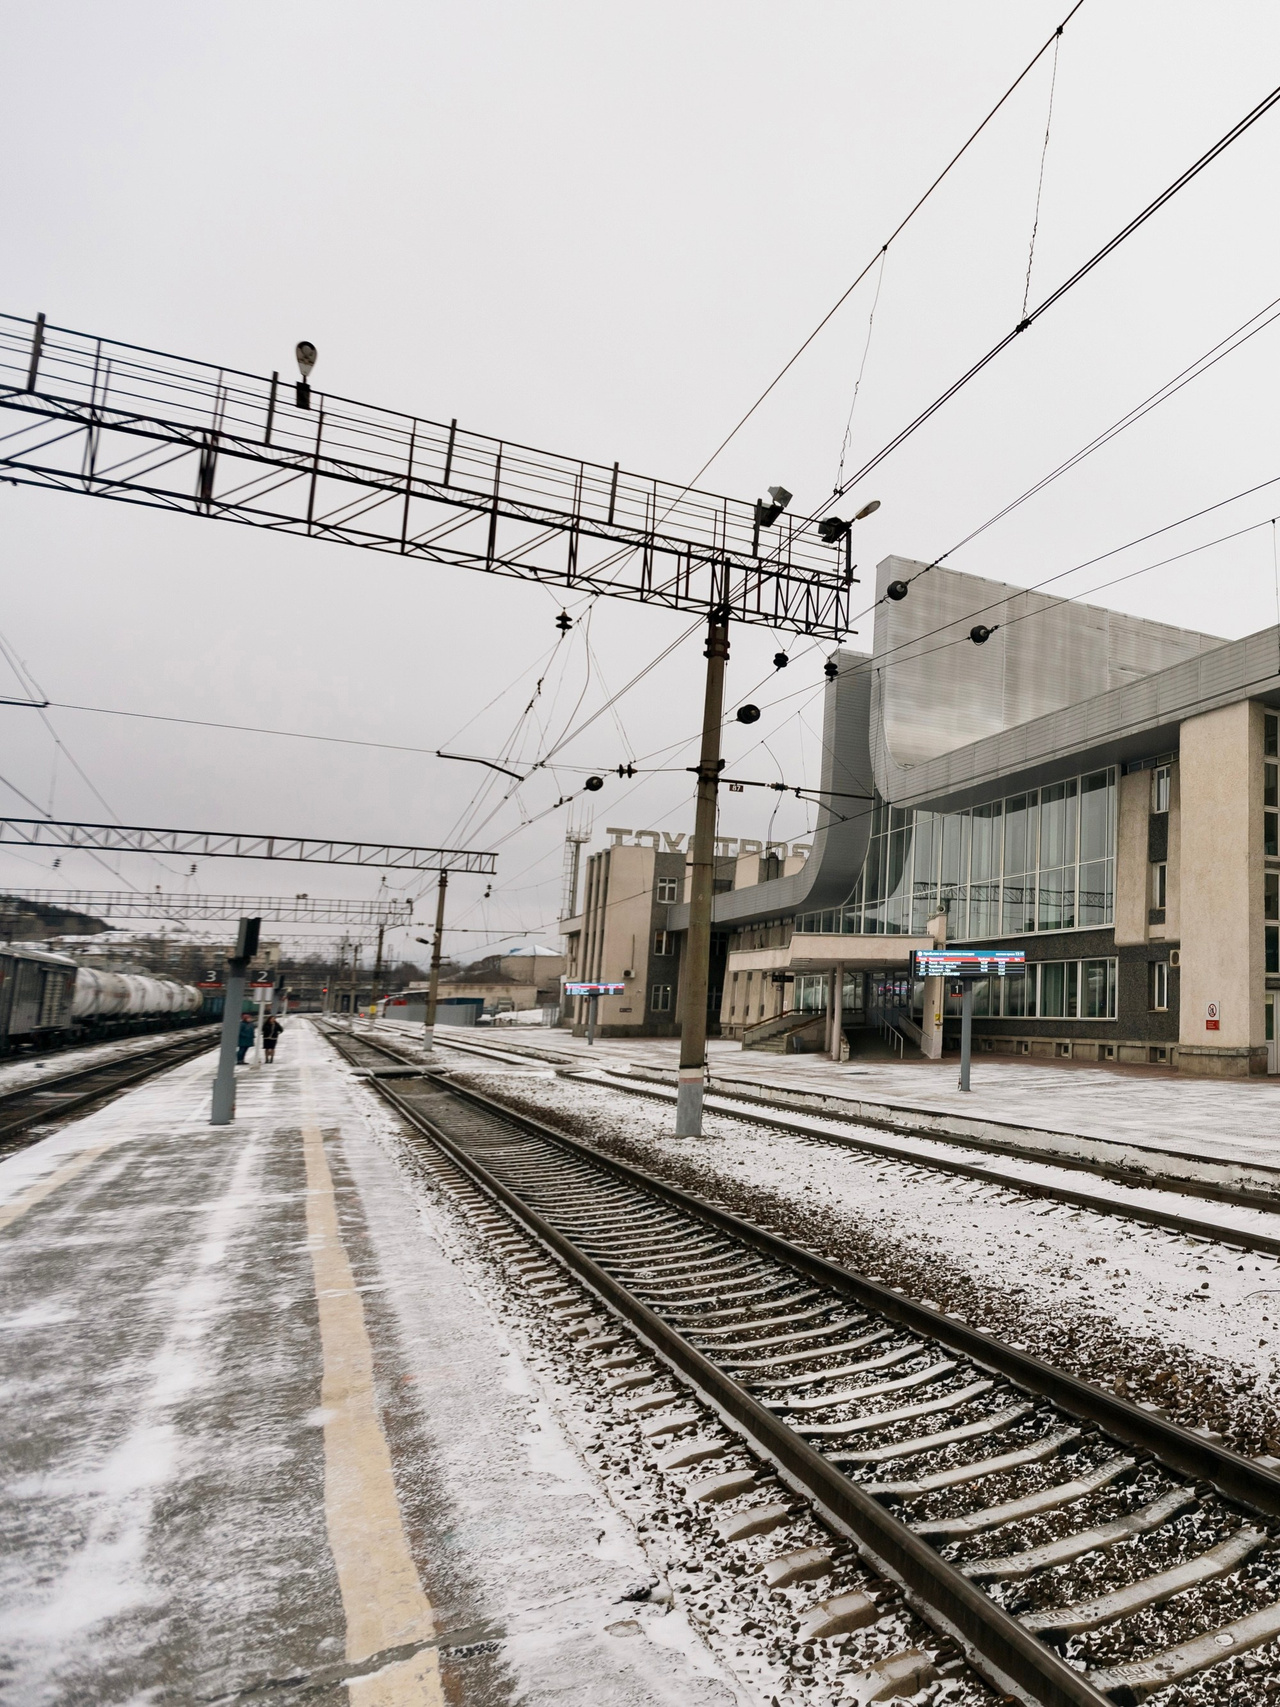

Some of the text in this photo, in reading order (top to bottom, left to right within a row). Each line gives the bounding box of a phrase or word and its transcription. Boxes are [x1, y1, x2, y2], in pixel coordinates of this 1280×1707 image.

[205, 970, 217, 982] 3
[257, 971, 268, 982] 2
[954, 985, 959, 994] 1
